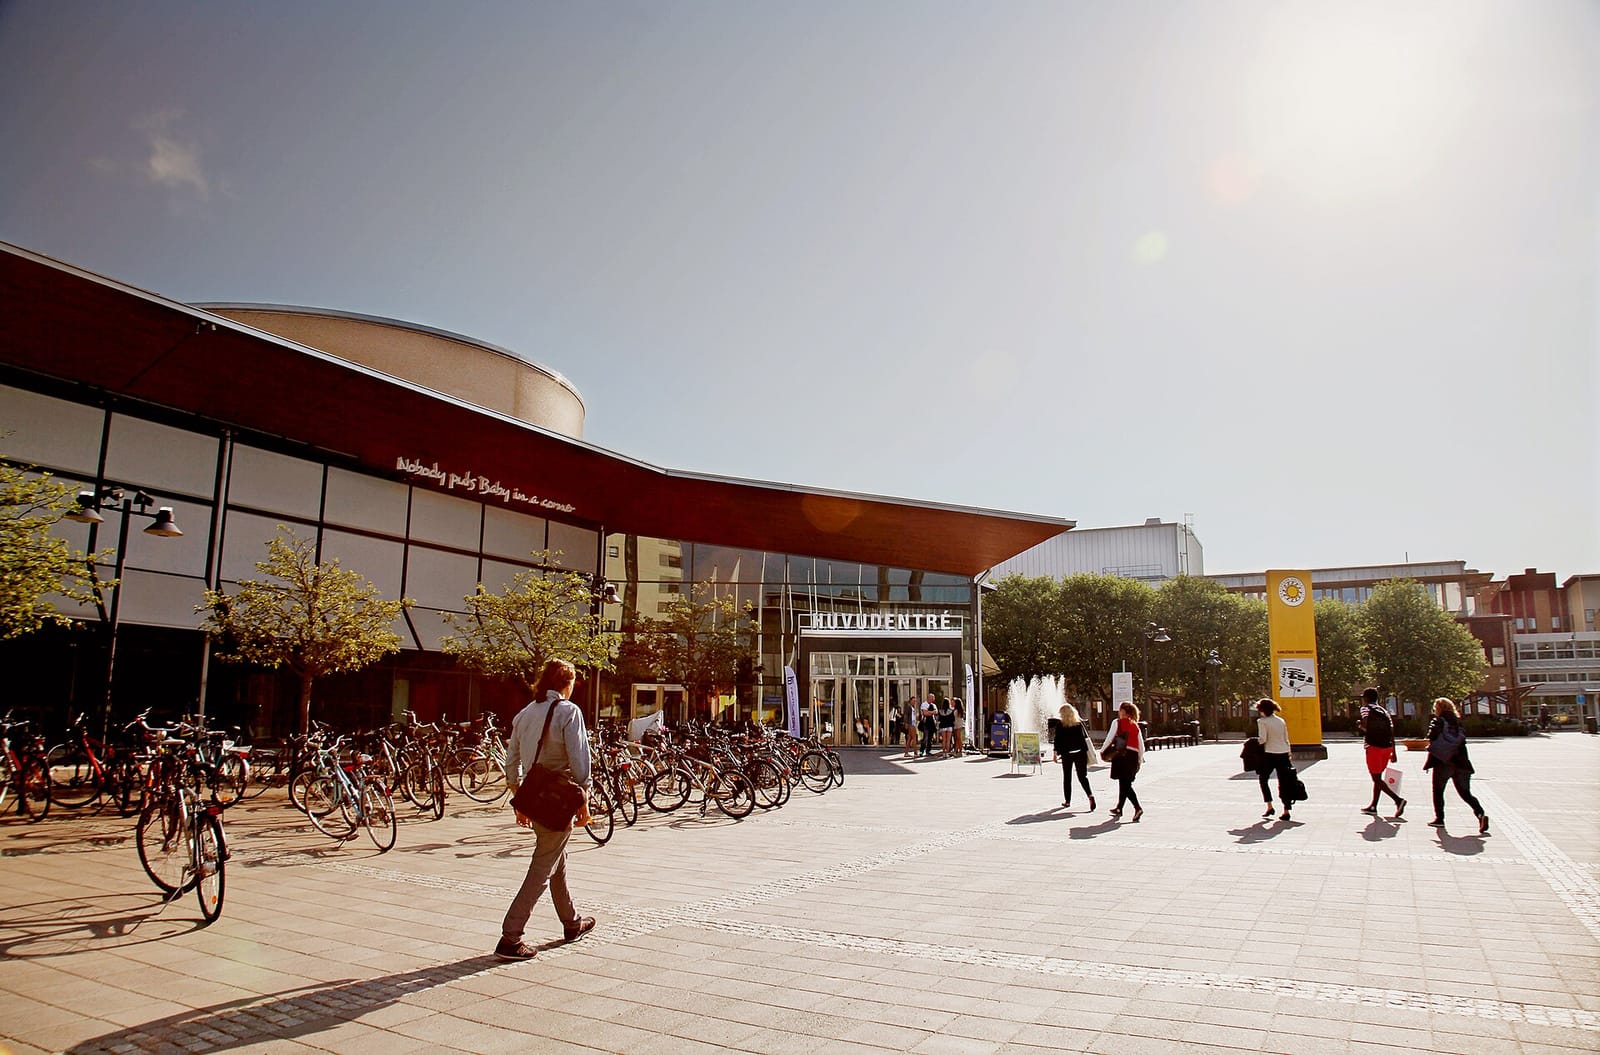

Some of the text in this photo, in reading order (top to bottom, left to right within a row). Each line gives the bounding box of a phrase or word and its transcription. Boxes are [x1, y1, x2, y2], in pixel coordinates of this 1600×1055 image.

[396, 456, 446, 486] Nobody
[448, 470, 477, 491] puts
[477, 475, 510, 502] Baby
[512, 487, 528, 501] in
[528, 495, 539, 504] a
[812, 610, 951, 630] HUVUDENTRÉ
